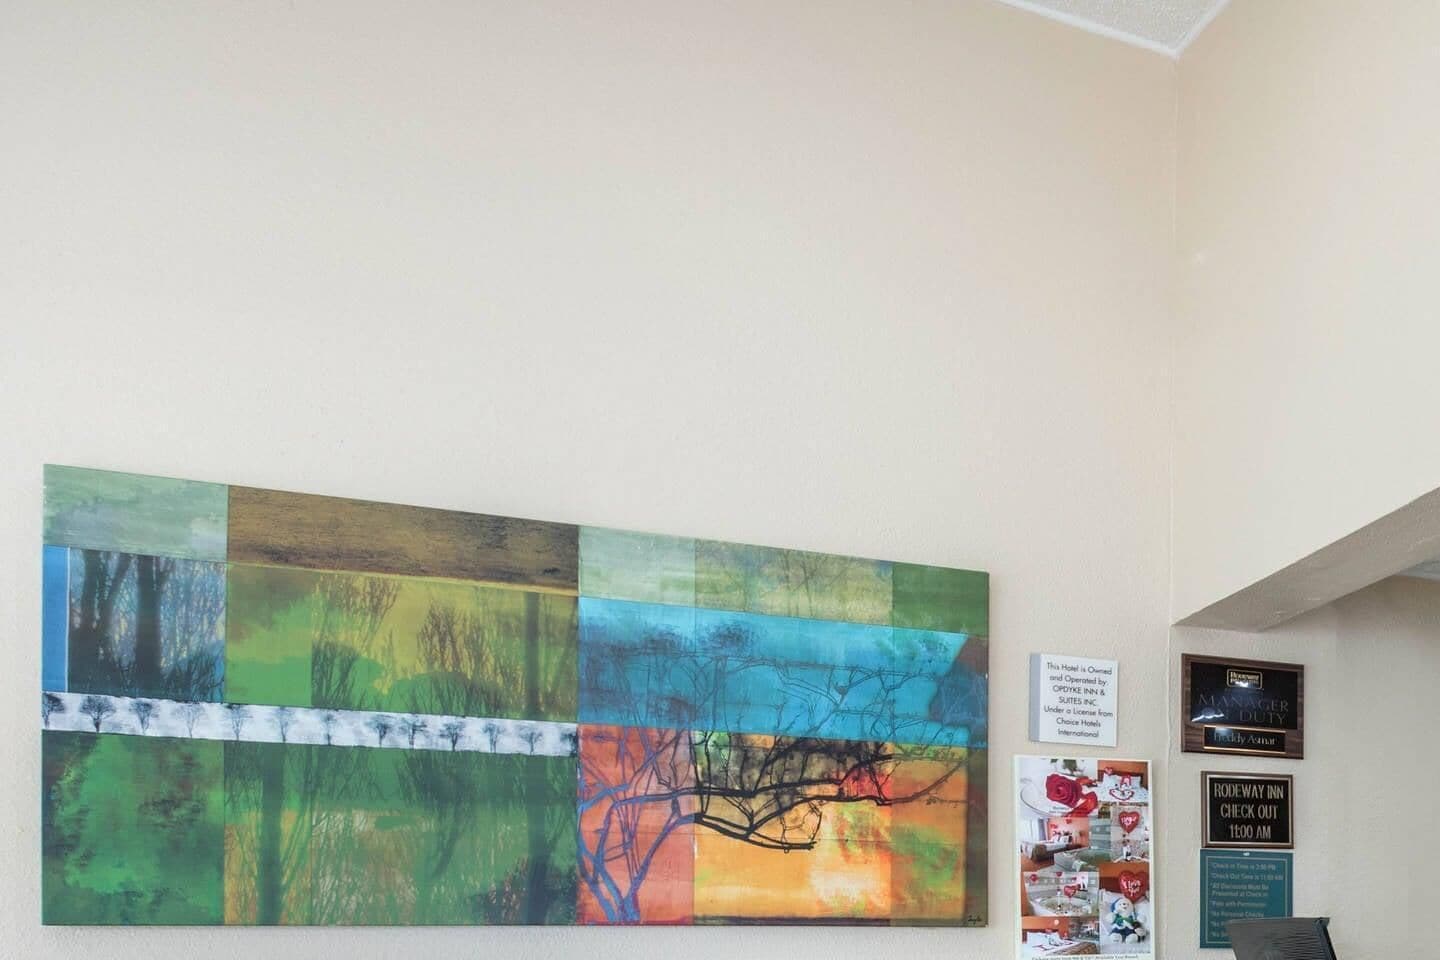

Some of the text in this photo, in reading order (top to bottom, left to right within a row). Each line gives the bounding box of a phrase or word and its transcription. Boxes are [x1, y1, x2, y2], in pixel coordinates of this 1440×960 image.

[1047, 662, 1059, 670] This
[1062, 664, 1079, 672] Hotel
[1087, 666, 1112, 675] Owned
[1064, 675, 1096, 684] Operated
[1053, 685, 1081, 694] OPDYKE
[1084, 688, 1098, 696] INN
[1058, 696, 1082, 705] SUITES
[1199, 693, 1288, 712] MANAGER
[1044, 705, 1064, 713] Under
[1073, 707, 1096, 716] License
[1098, 709, 1113, 717] from
[1056, 717, 1101, 727] Choice Hotels
[1241, 709, 1286, 726] DUTY
[1058, 728, 1099, 738] International
[1214, 782, 1284, 800] RODEWAY INN
[1220, 803, 1278, 819] CHECK OUT
[1230, 824, 1271, 839] 11:00 AM
